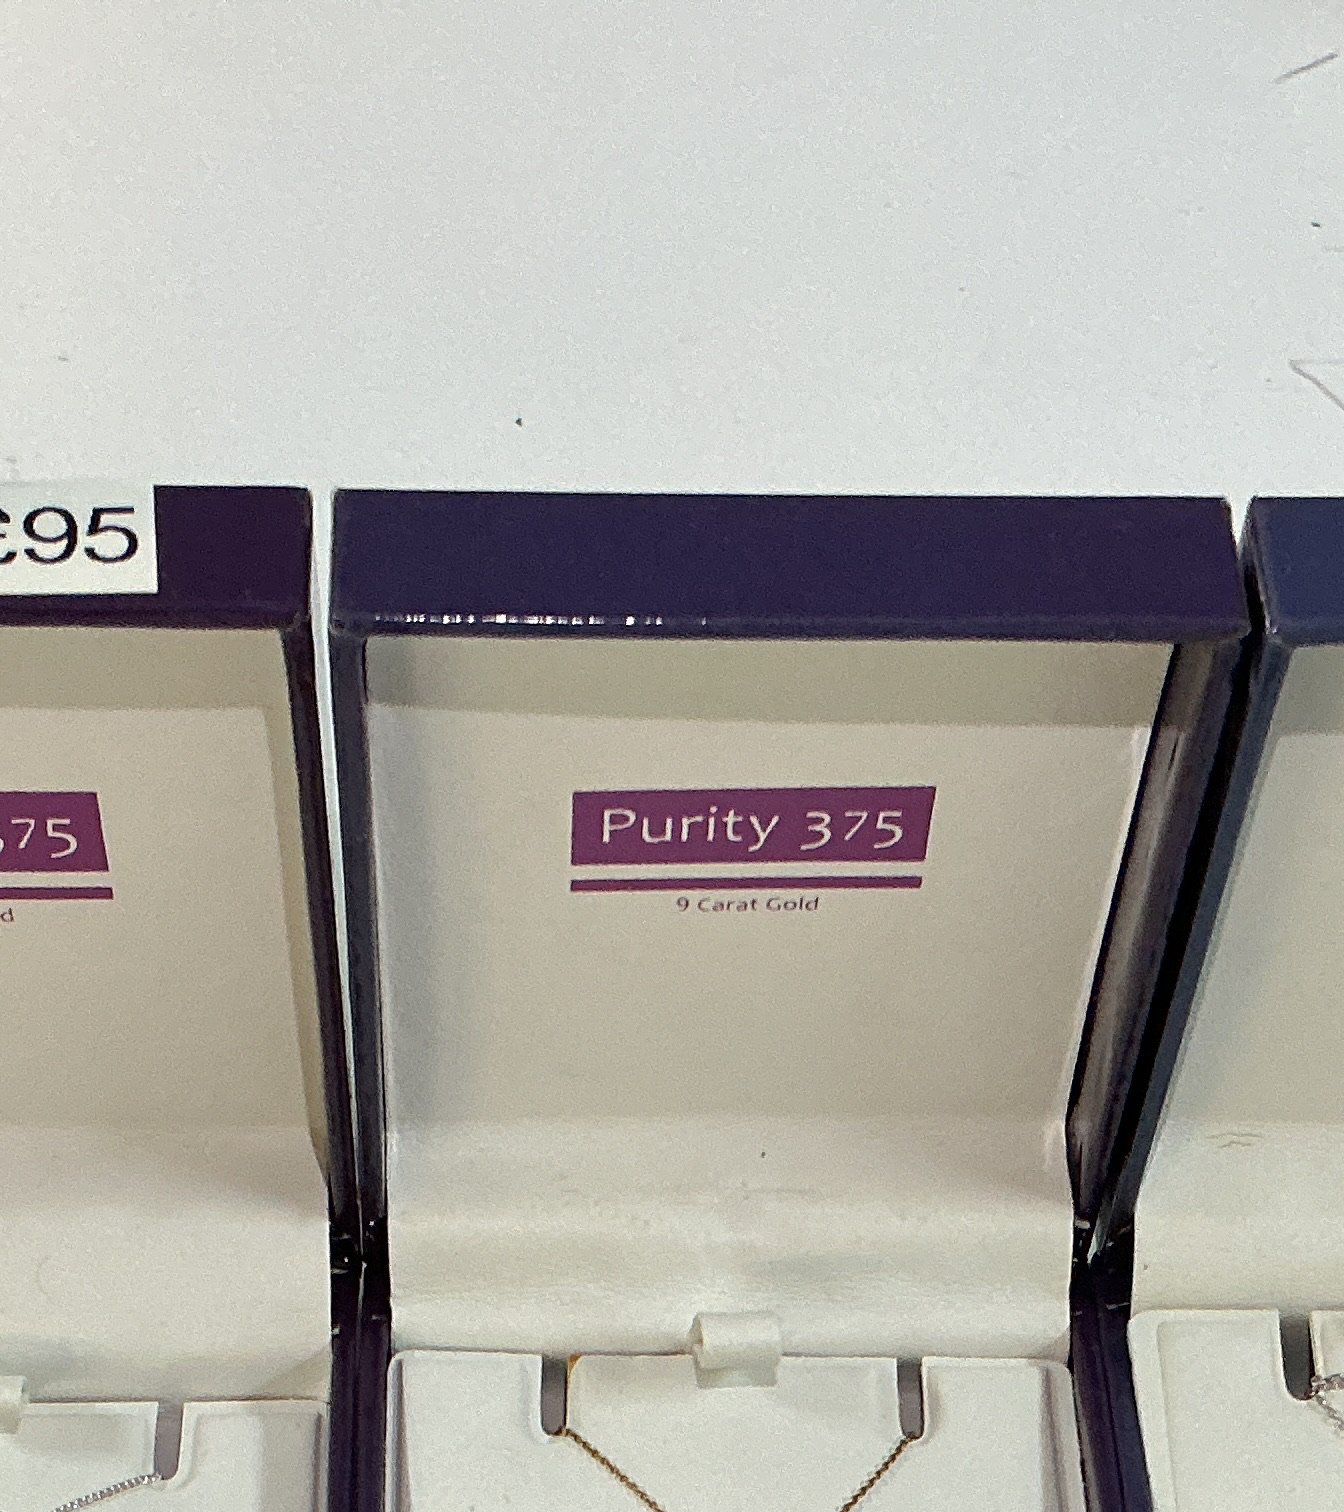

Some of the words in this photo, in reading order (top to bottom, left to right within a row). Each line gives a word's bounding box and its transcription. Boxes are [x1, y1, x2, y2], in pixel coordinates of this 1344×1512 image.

[602, 805, 780, 852] Purity
[800, 810, 903, 851] 375
[676, 897, 690, 912] 9
[697, 898, 758, 913] Carat
[765, 896, 820, 912] Gold
